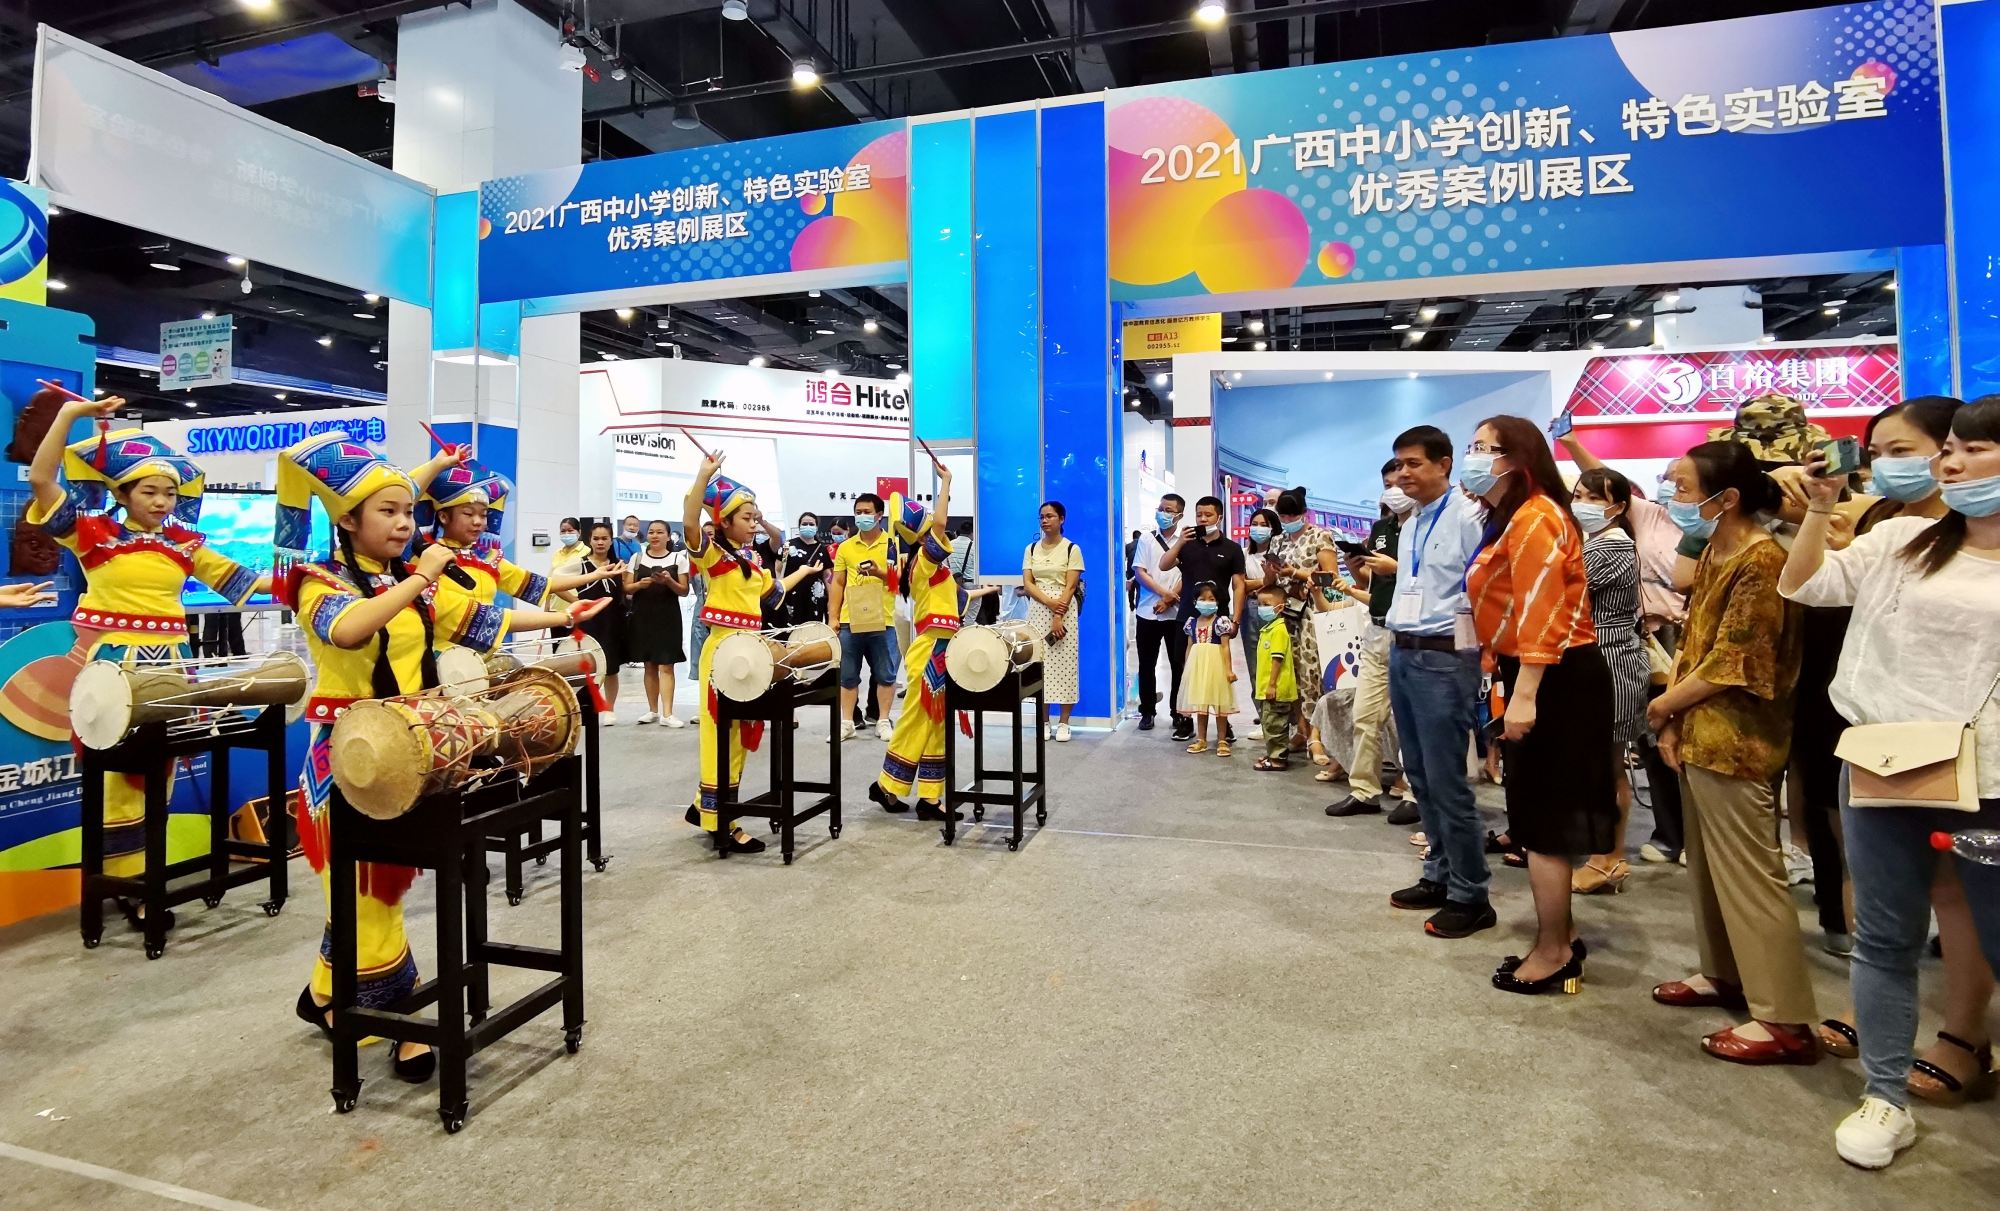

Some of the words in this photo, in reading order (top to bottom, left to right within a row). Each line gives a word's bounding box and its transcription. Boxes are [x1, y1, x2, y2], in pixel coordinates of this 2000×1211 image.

[1141, 75, 1889, 185] 2021广西中小学创新、特色实验室
[504, 164, 871, 234] 2021广西中小学创新、特色实验室
[1349, 151, 1634, 216] 优秀案例展区
[607, 212, 748, 253] 优秀案例展区
[806, 379, 852, 406] 鸿合
[187, 422, 306, 454] SKYWORTH
[0, 752, 83, 793] 金城江
[9, 796, 44, 809] Cheng
[45, 788, 75, 802] Jiang
